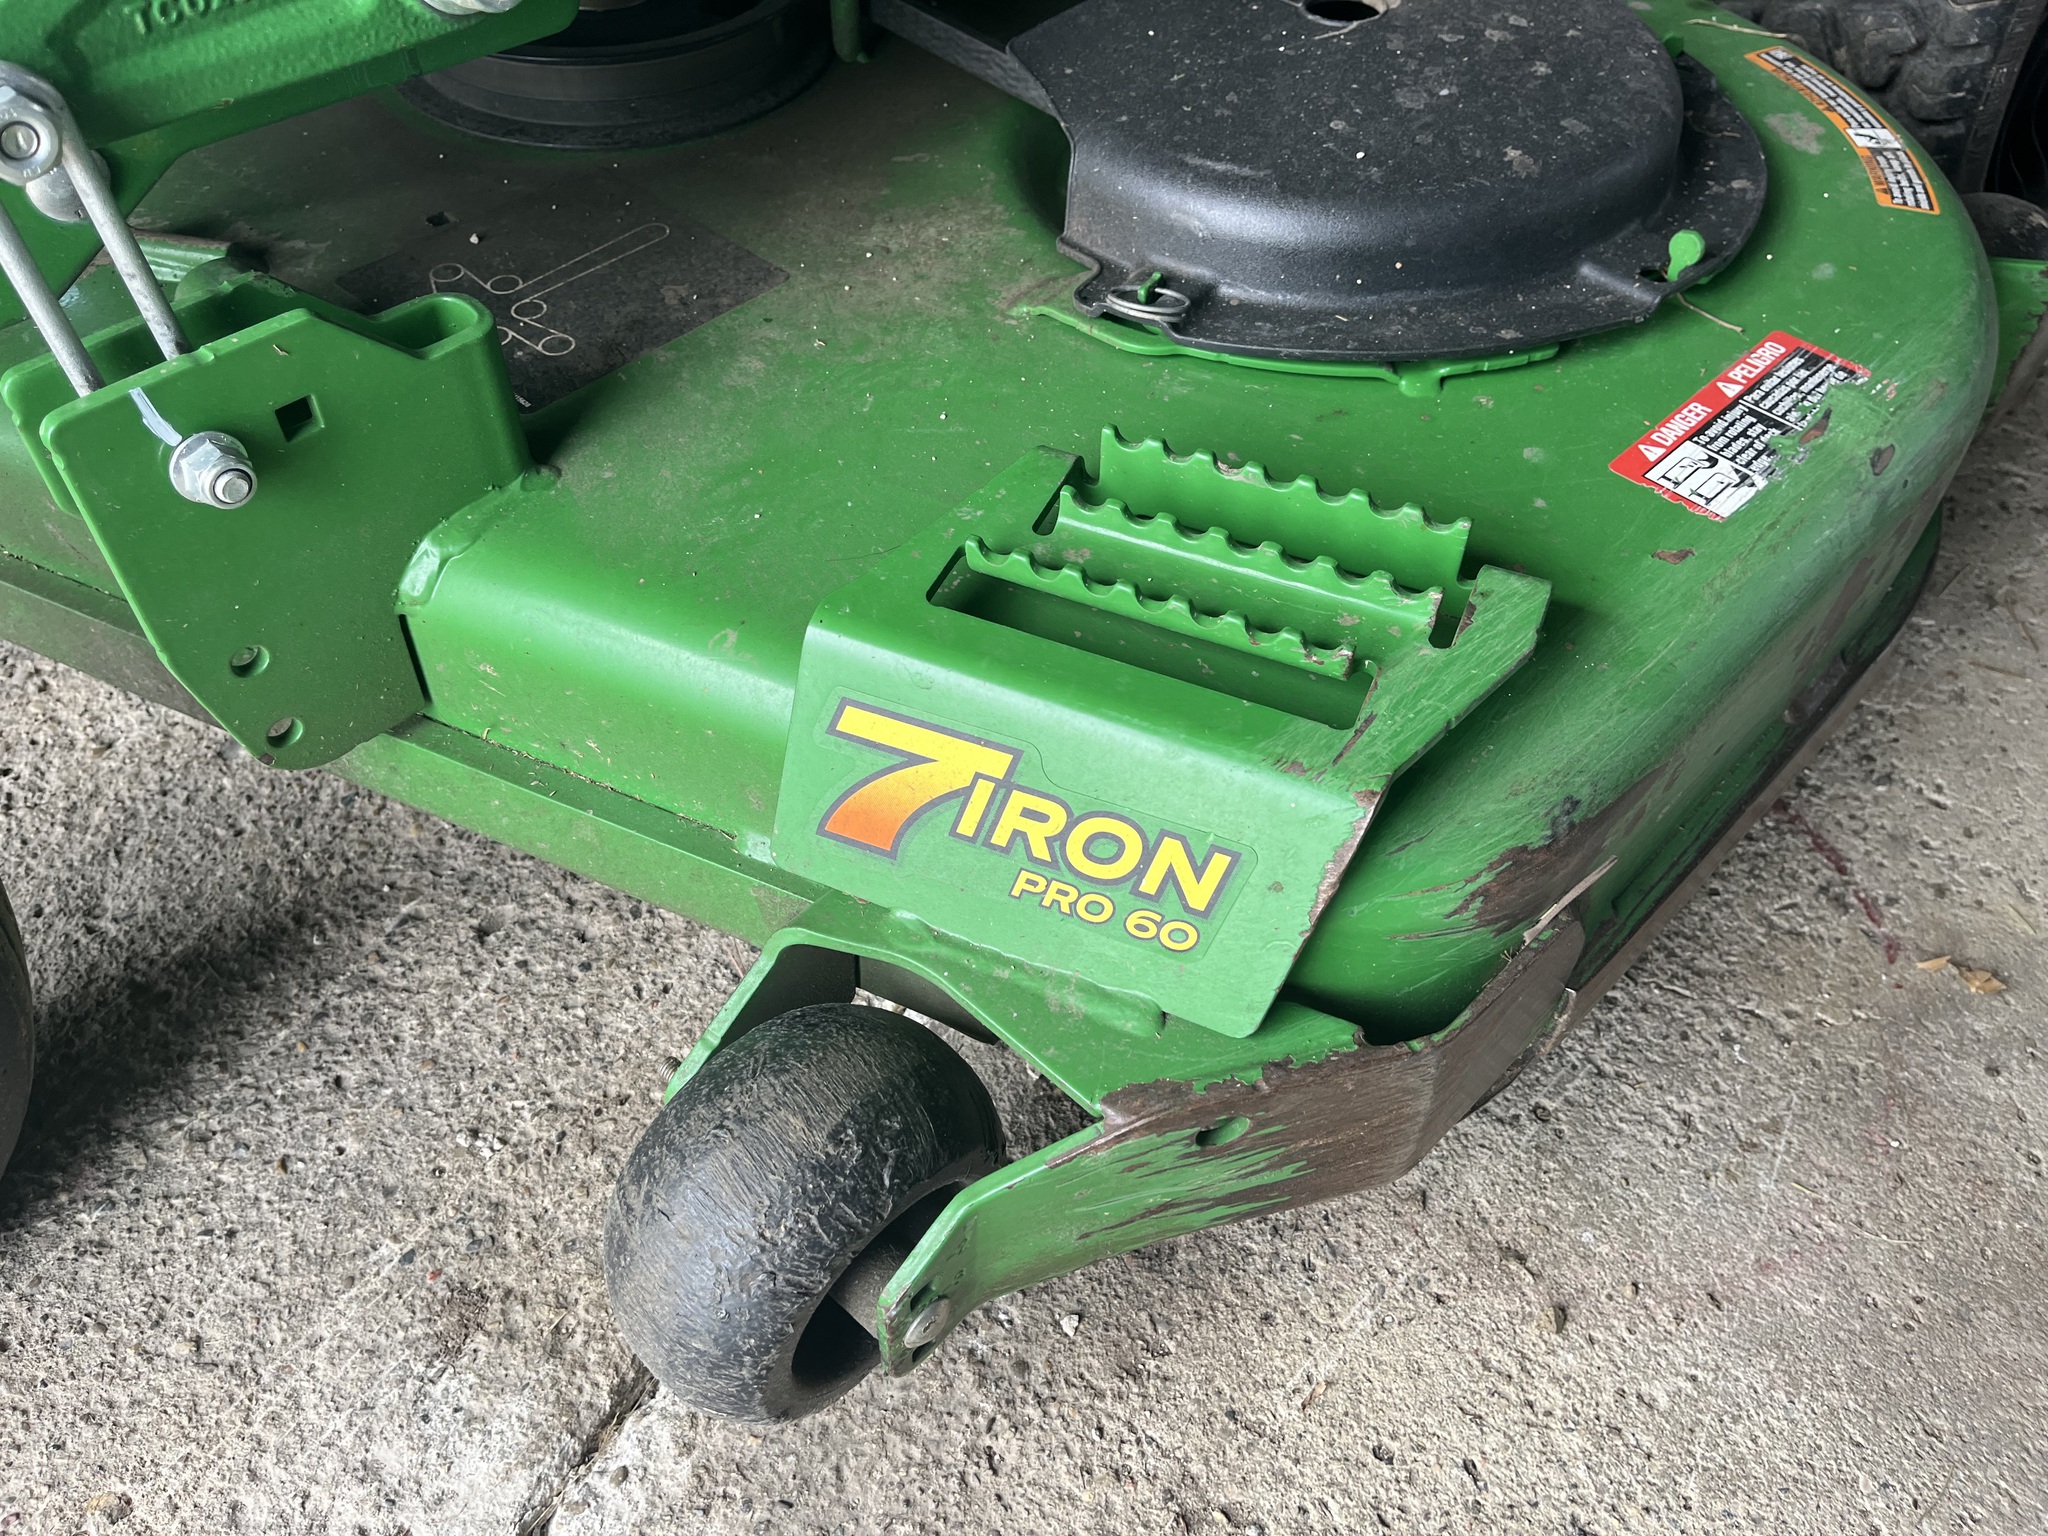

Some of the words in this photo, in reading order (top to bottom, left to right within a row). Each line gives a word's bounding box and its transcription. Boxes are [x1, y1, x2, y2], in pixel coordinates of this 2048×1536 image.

[1727, 341, 1786, 383] PELIGRO
[1743, 389, 1765, 403] Para
[1649, 402, 1712, 446] DANGER
[1692, 434, 1710, 444] To
[1704, 418, 1729, 437] avoid
[1720, 403, 1748, 422] injury
[1706, 435, 1729, 451] from
[1719, 413, 1757, 438] rotating
[1746, 421, 1767, 437] stay
[1735, 447, 1757, 464] clear
[1752, 439, 1765, 450] of
[816, 696, 1024, 860] 7
[949, 773, 1241, 918] IRON
[1009, 868, 1116, 927] PRO
[1124, 909, 1200, 953] 60
